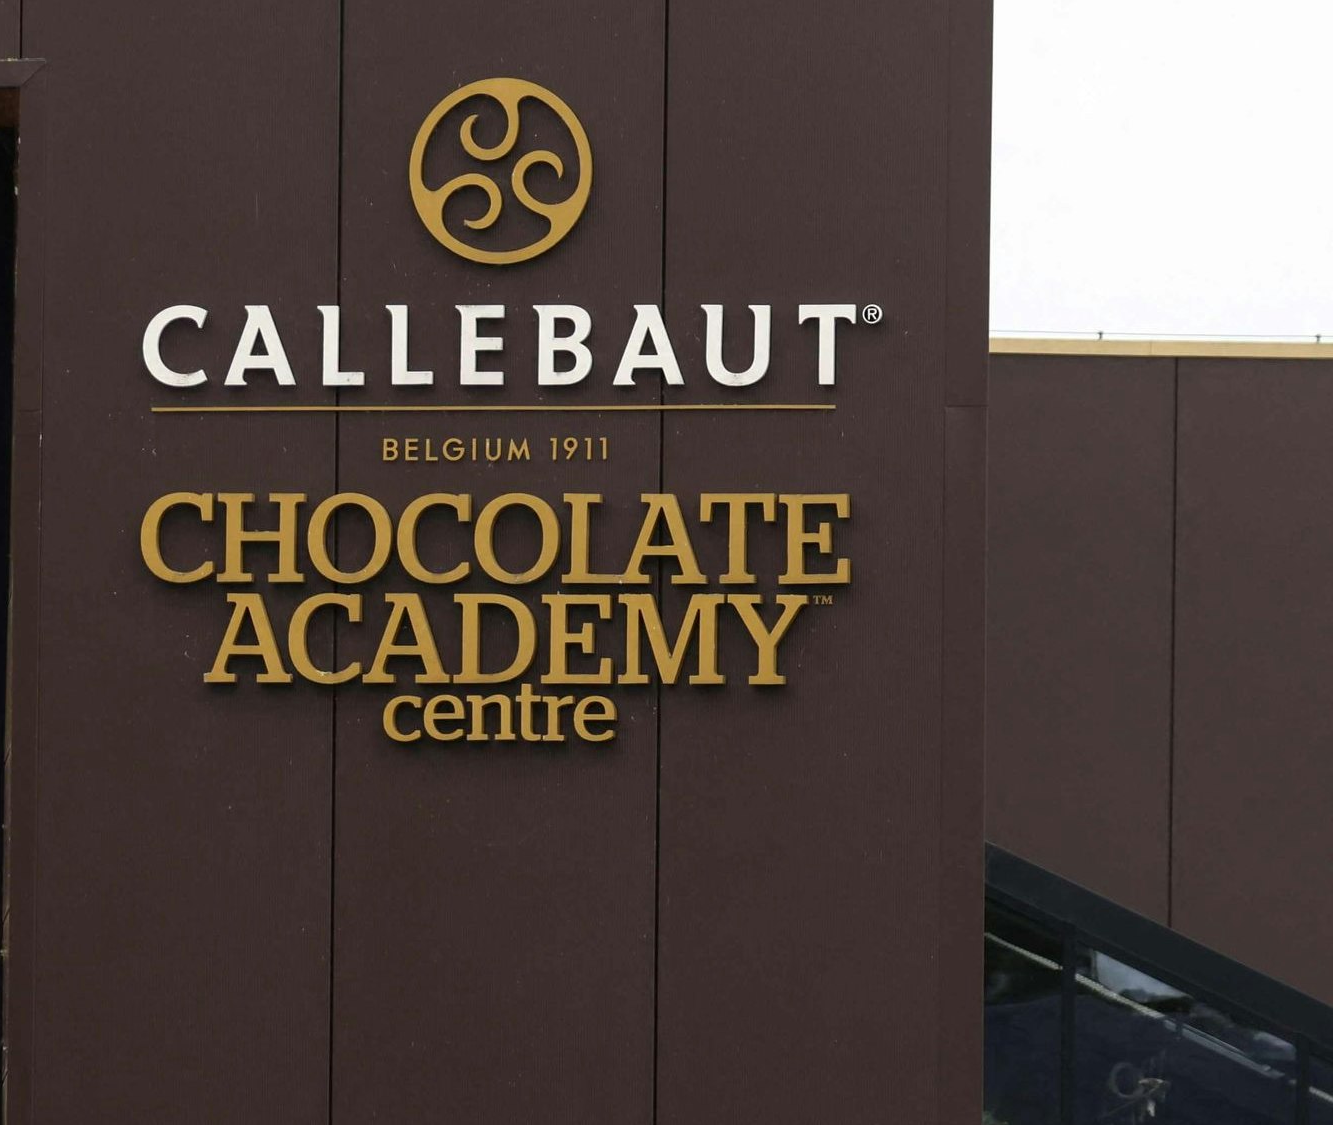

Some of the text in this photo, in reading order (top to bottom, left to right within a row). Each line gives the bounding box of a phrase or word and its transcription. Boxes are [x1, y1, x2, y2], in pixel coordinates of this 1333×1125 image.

[382, 436, 610, 462] BELGIUM 1911
[139, 491, 851, 585] CHOCOLATE
[382, 683, 617, 742] centre
